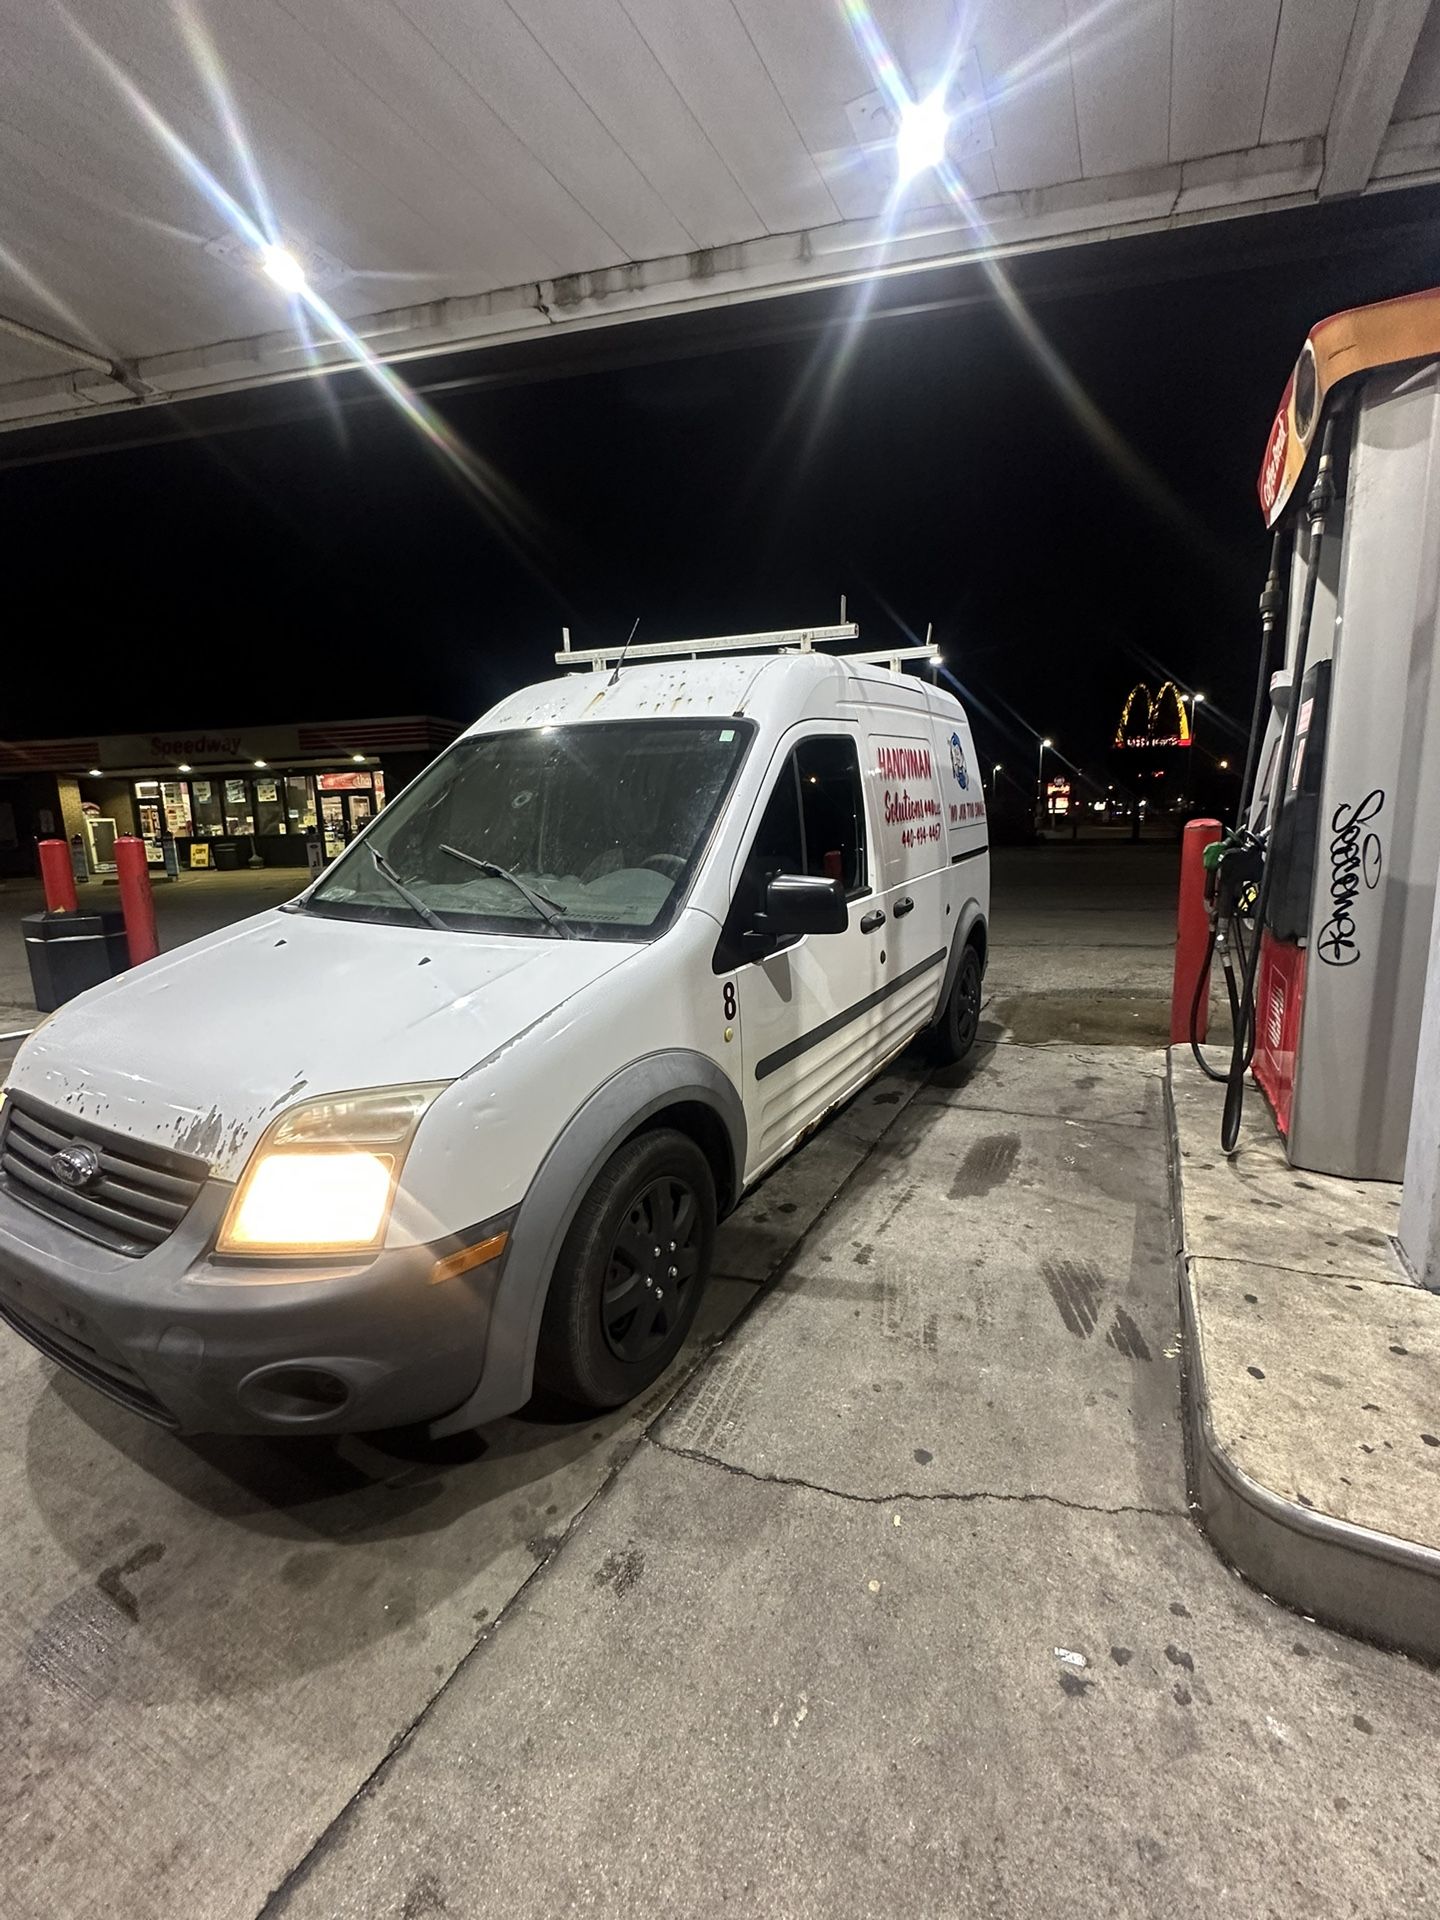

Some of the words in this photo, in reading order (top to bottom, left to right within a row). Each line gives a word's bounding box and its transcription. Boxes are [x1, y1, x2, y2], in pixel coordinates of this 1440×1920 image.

[151, 735, 242, 759] Speedway
[877, 747, 932, 780] HANDYMAN
[885, 788, 925, 825] Solutions
[723, 981, 736, 1020] 8
